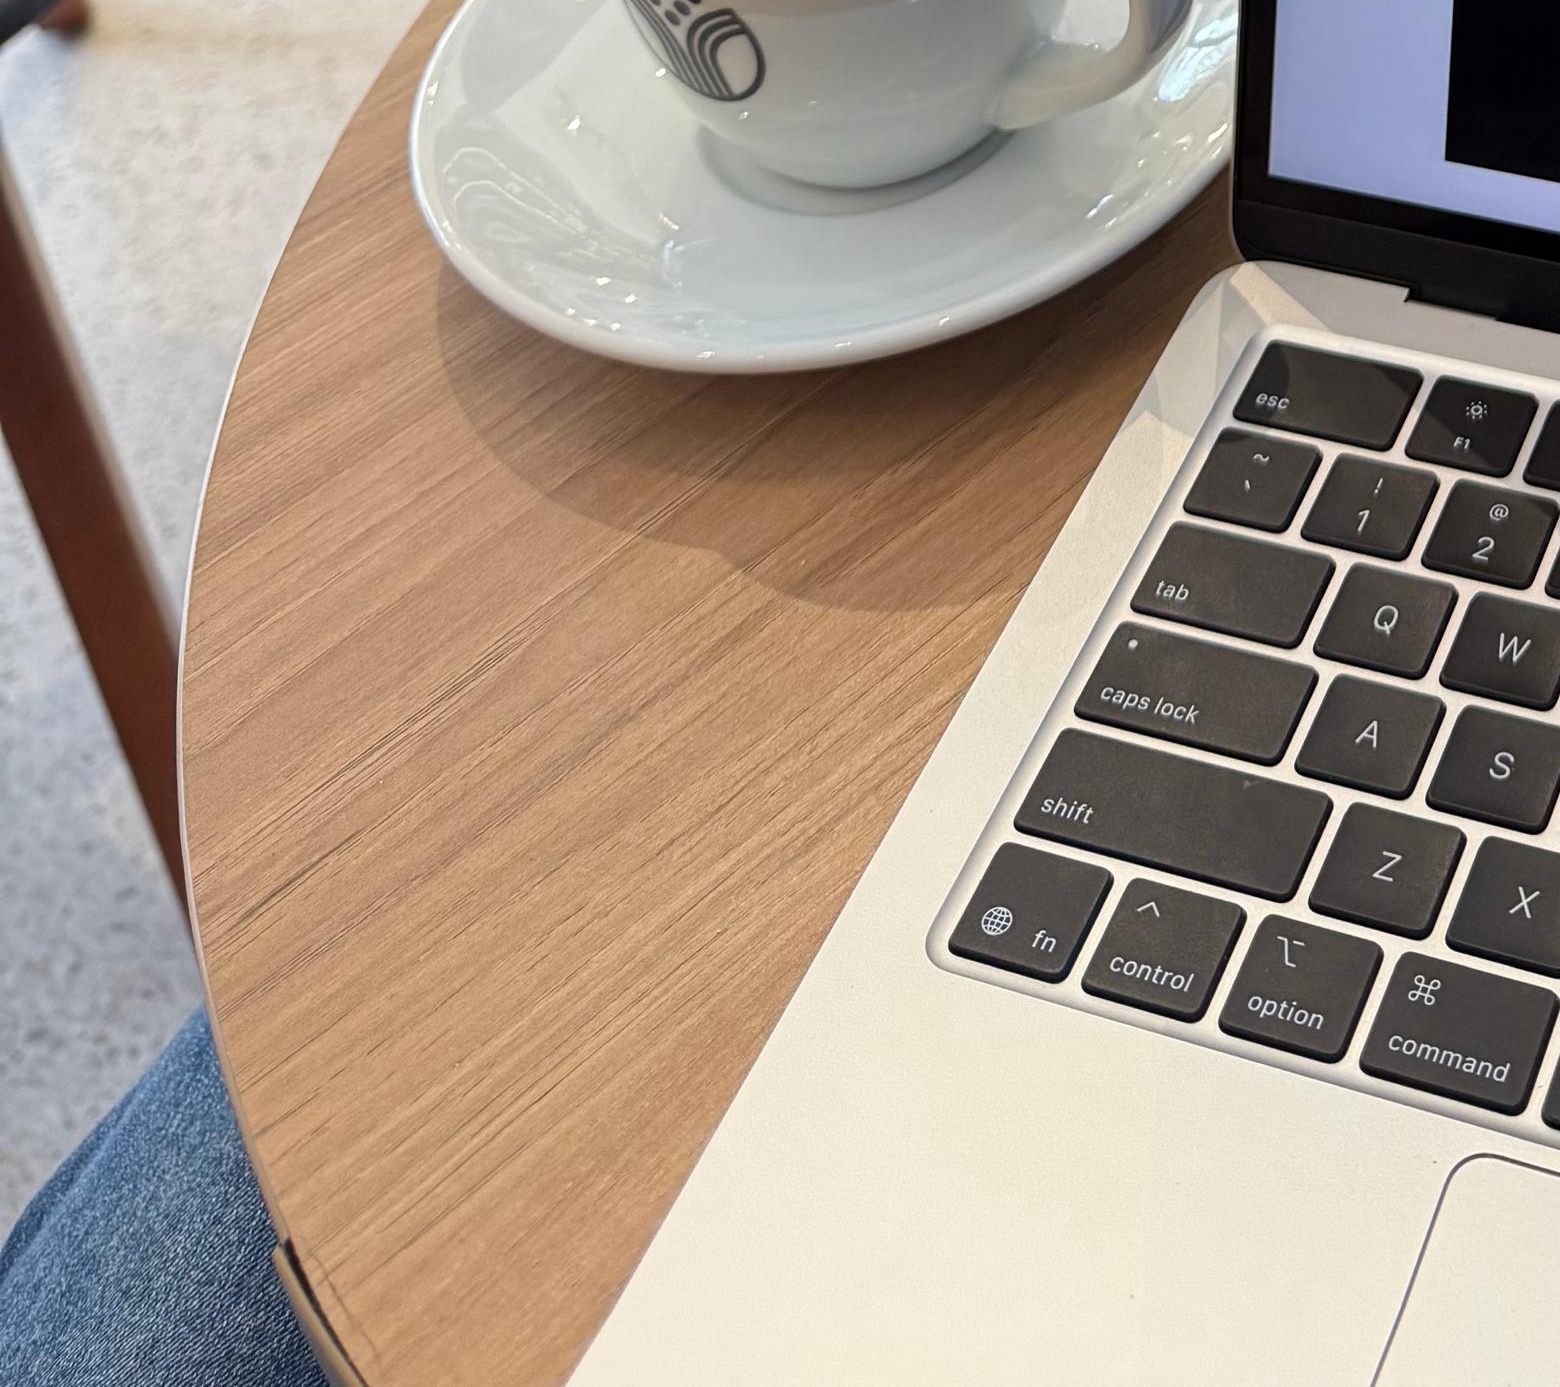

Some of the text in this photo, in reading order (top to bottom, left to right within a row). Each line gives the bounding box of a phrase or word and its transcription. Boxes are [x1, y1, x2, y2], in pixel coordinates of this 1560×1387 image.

[1255, 393, 1290, 410] esc
[1453, 436, 1471, 450] F1
[1155, 580, 1189, 601] tab
[1100, 687, 1200, 724] caps lock
[1040, 797, 1094, 824] shift
[1031, 929, 1057, 953] fn
[1109, 956, 1195, 992] control
[1247, 996, 1324, 1030] option
[1388, 1032, 1511, 1084] command
